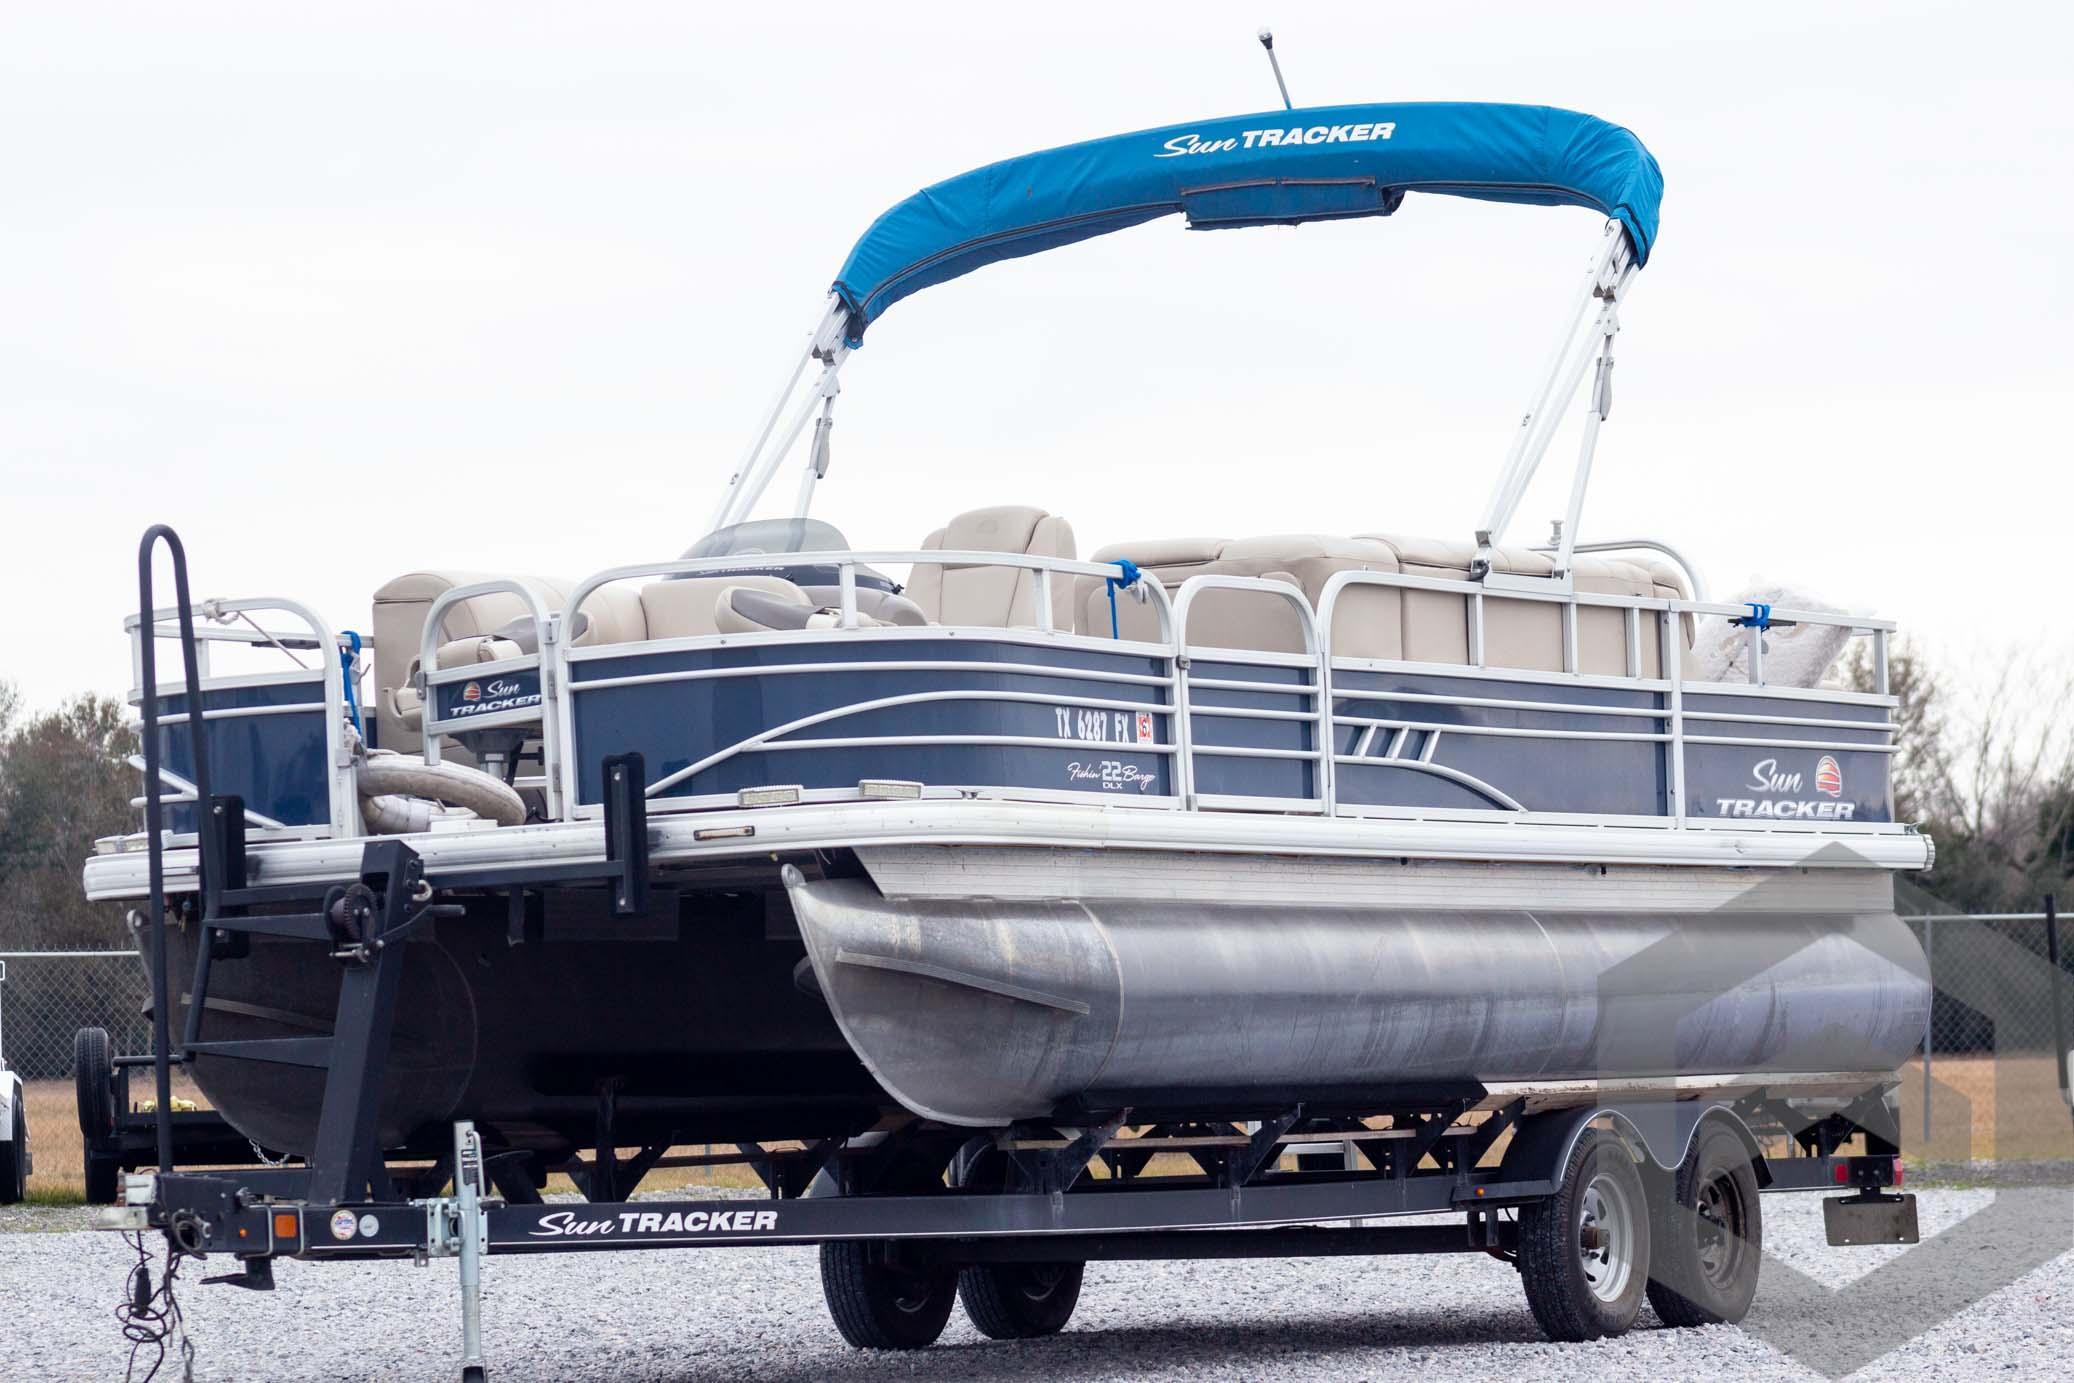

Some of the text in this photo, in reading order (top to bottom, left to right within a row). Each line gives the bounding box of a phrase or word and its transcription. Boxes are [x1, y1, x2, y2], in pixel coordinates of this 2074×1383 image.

[1153, 122, 1397, 158] Sun TRACKER
[482, 680, 520, 699] Sun
[450, 694, 542, 717] TRACKER
[1055, 706, 1130, 743] TX 6287 FX
[1102, 761, 1121, 781] 22
[1121, 765, 1157, 791] Barge
[1102, 782, 1123, 790] DLX
[1746, 758, 1803, 793] Sun
[1716, 798, 1856, 820] TRACKER
[528, 1211, 779, 1236] Sun TRACKER
